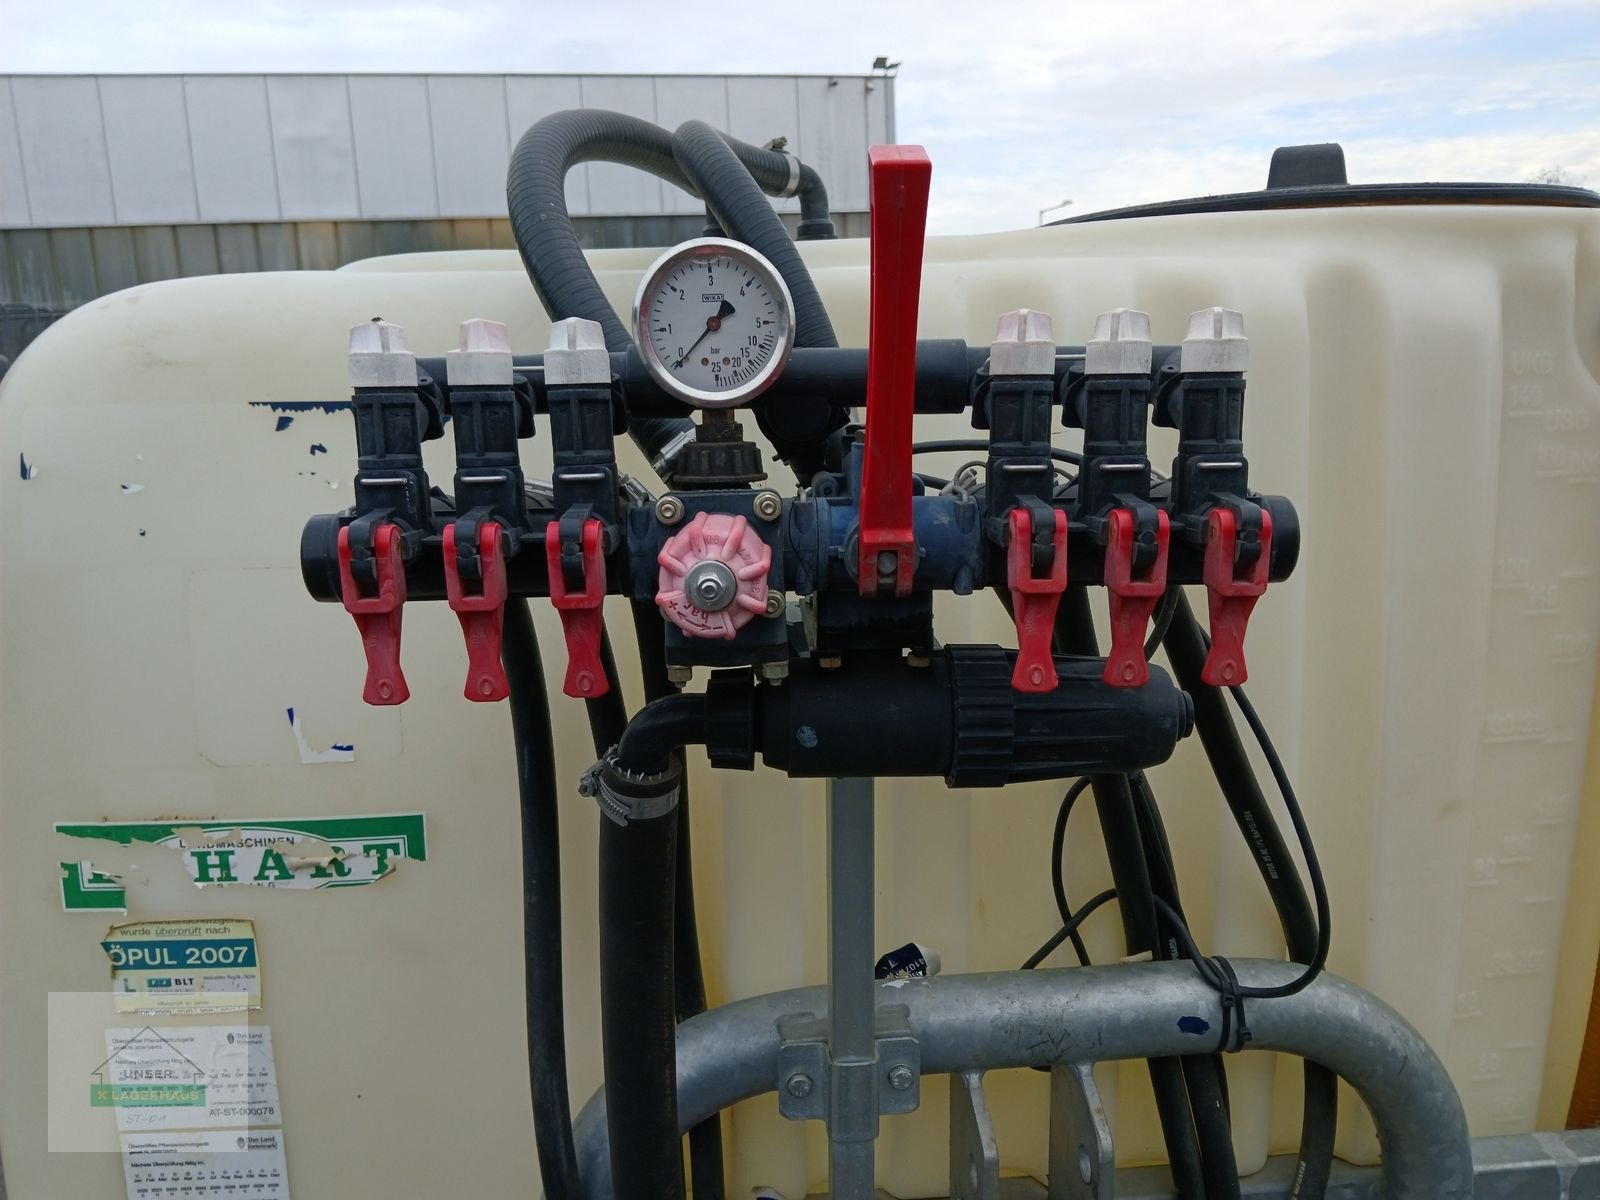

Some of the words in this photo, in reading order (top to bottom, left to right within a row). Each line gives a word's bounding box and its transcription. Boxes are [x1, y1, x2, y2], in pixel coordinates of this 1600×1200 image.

[708, 275, 714, 286] 3
[679, 289, 685, 300] 2
[740, 286, 745, 296] 4
[756, 317, 761, 328] 5
[668, 324, 672, 334] 1
[748, 336, 758, 346] 10
[678, 347, 684, 357] 0
[710, 346, 720, 354] bar
[740, 348, 750, 358] 15
[711, 362, 721, 372] 25
[732, 357, 741, 367] 20
[120, 928, 151, 936] wurde
[155, 926, 201, 937] überprüft
[206, 926, 230, 935] nach
[110, 944, 177, 966] ÖPUL
[185, 946, 248, 964] 2007
[175, 978, 194, 986] BLT
[209, 1107, 275, 1117] AT-ST-000078
